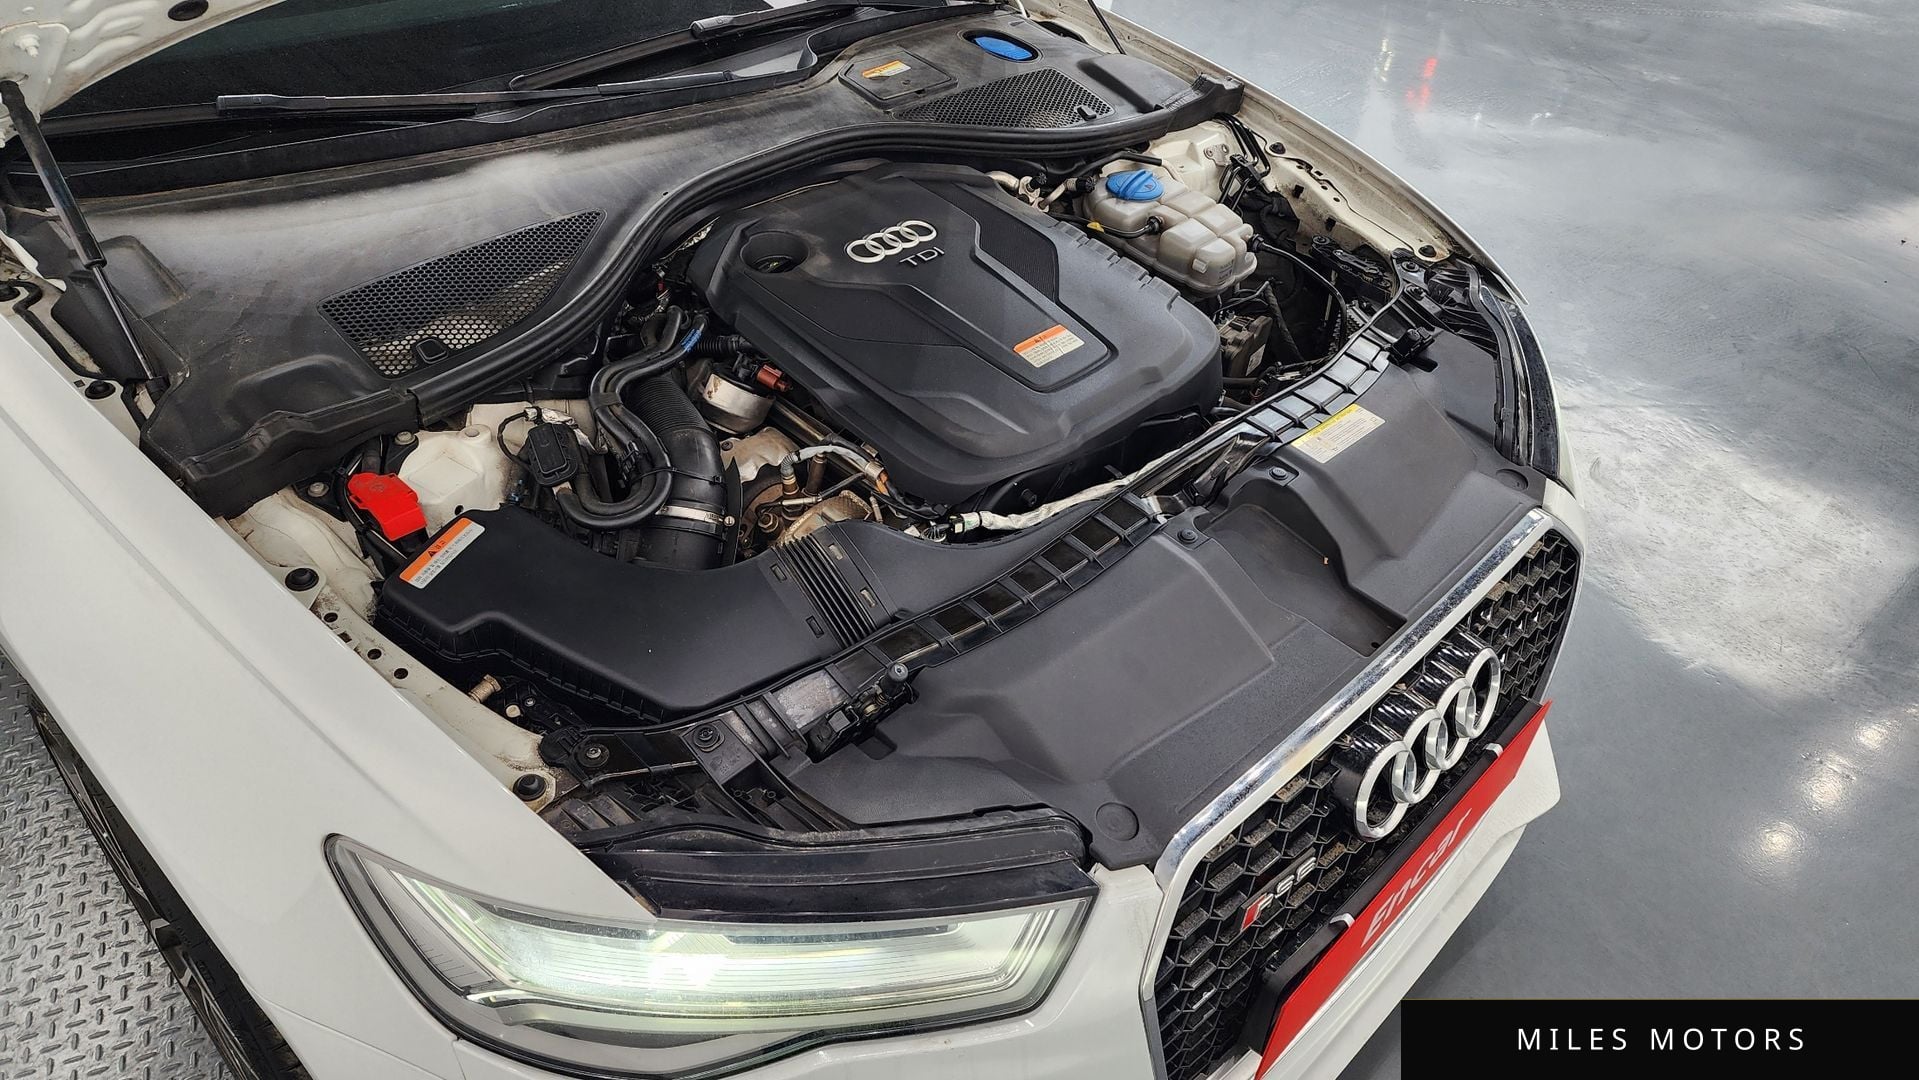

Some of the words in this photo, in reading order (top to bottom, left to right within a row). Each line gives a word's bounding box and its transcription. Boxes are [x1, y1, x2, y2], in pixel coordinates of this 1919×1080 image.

[899, 246, 946, 266] TDI
[1248, 857, 1317, 924] RS6
[1360, 807, 1473, 949] Encar
